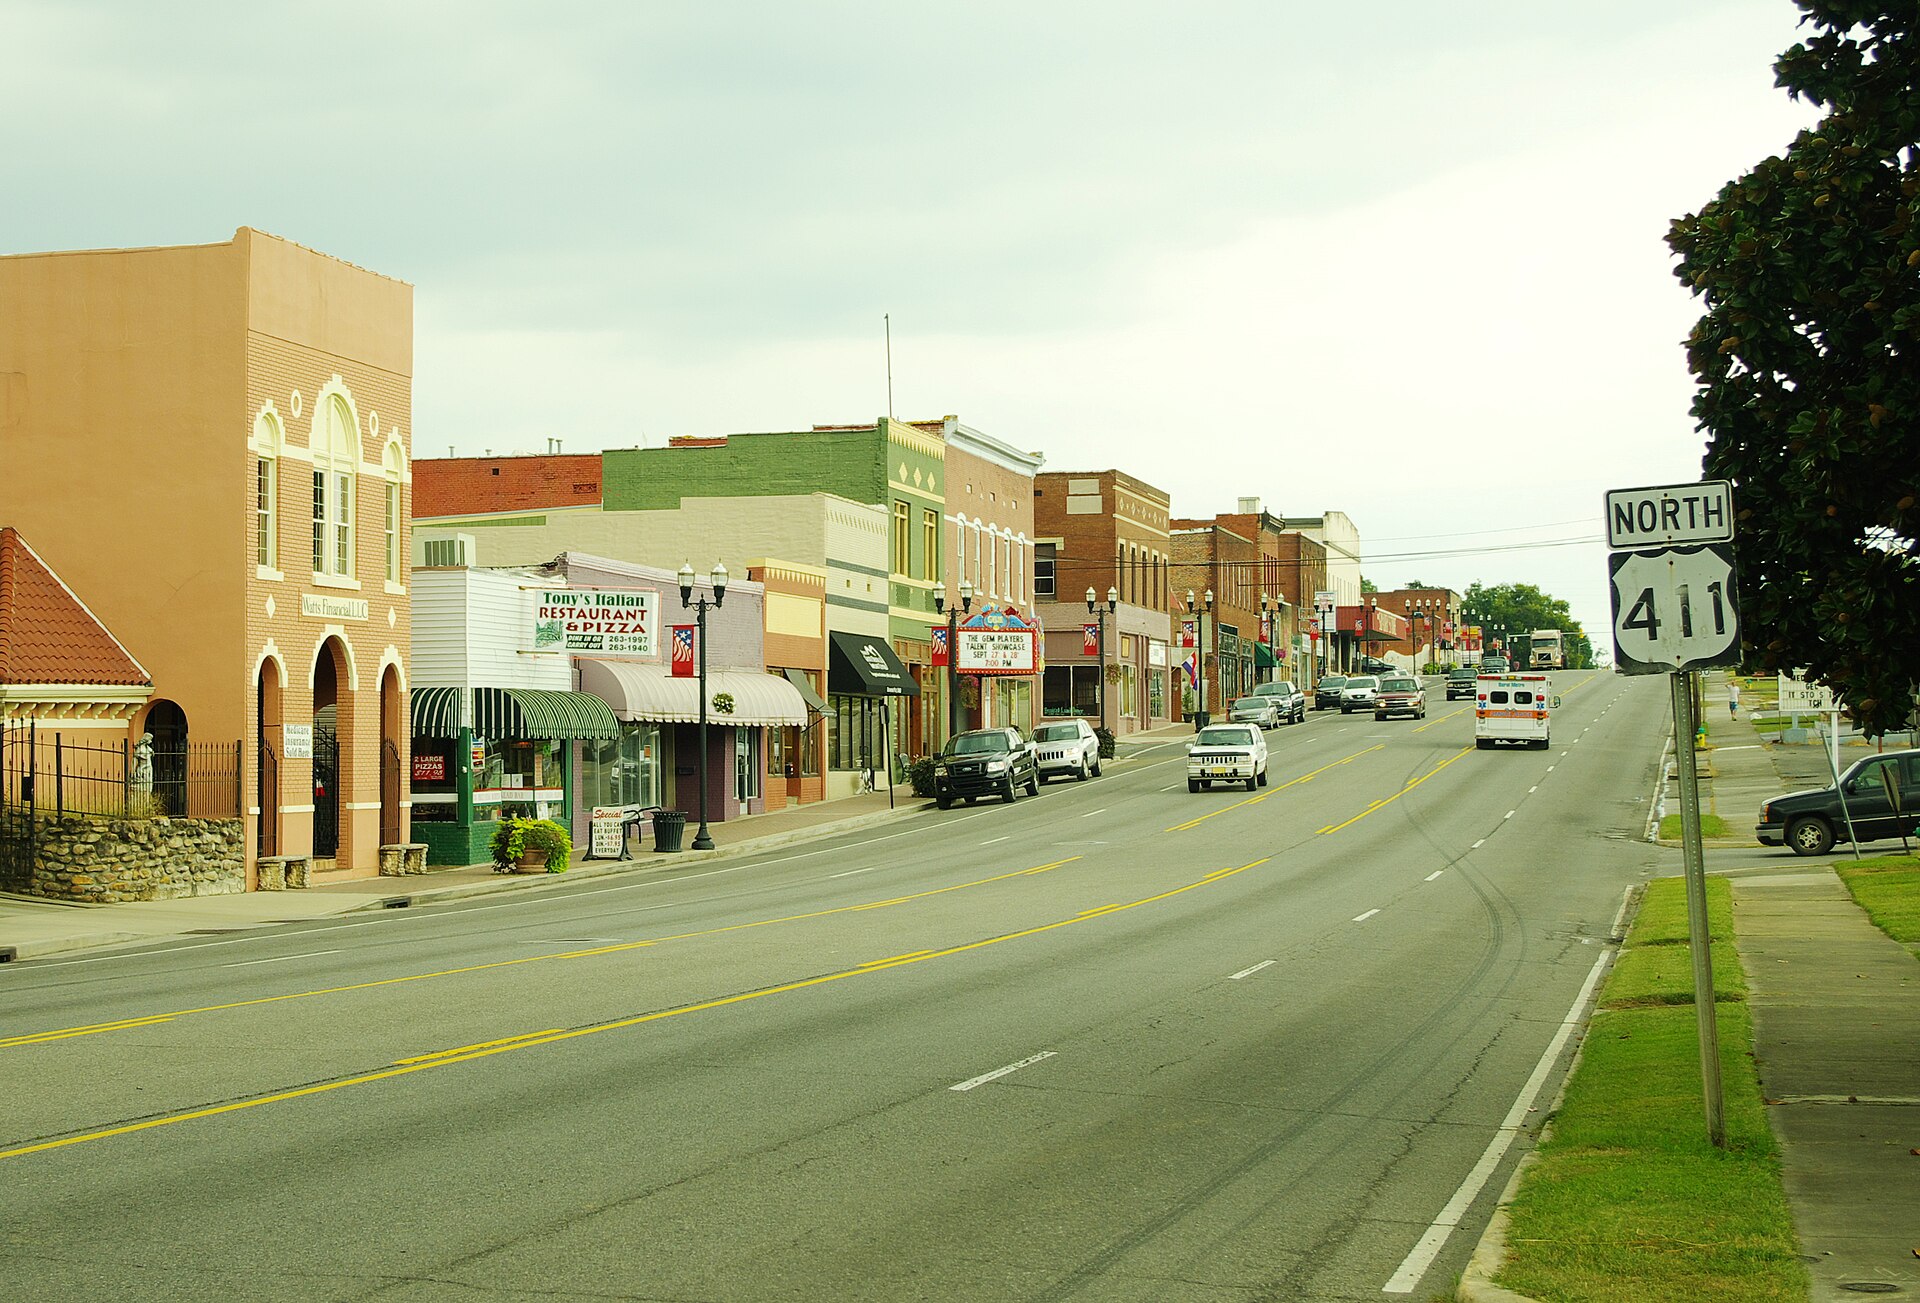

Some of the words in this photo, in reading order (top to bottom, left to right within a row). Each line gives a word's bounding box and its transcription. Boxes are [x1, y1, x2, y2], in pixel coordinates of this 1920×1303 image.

[1614, 495, 1723, 535] NORTH
[543, 592, 590, 606] Tony's
[595, 594, 644, 607] Italian
[302, 596, 321, 614] Watts
[322, 598, 351, 617] Financial
[351, 601, 368, 619] LLC
[1622, 581, 1725, 641] 411
[539, 607, 647, 621] RESTAURANT
[565, 622, 579, 632] &
[583, 622, 646, 634] PIZZA
[608, 635, 648, 643] 263-1997
[997, 635, 1024, 643] PLAYERS
[608, 644, 648, 652] 263-1940
[966, 643, 987, 651] TALENT
[992, 643, 1026, 651] SHOWCASE
[973, 651, 987, 659] SEPT
[593, 809, 622, 820] Special
